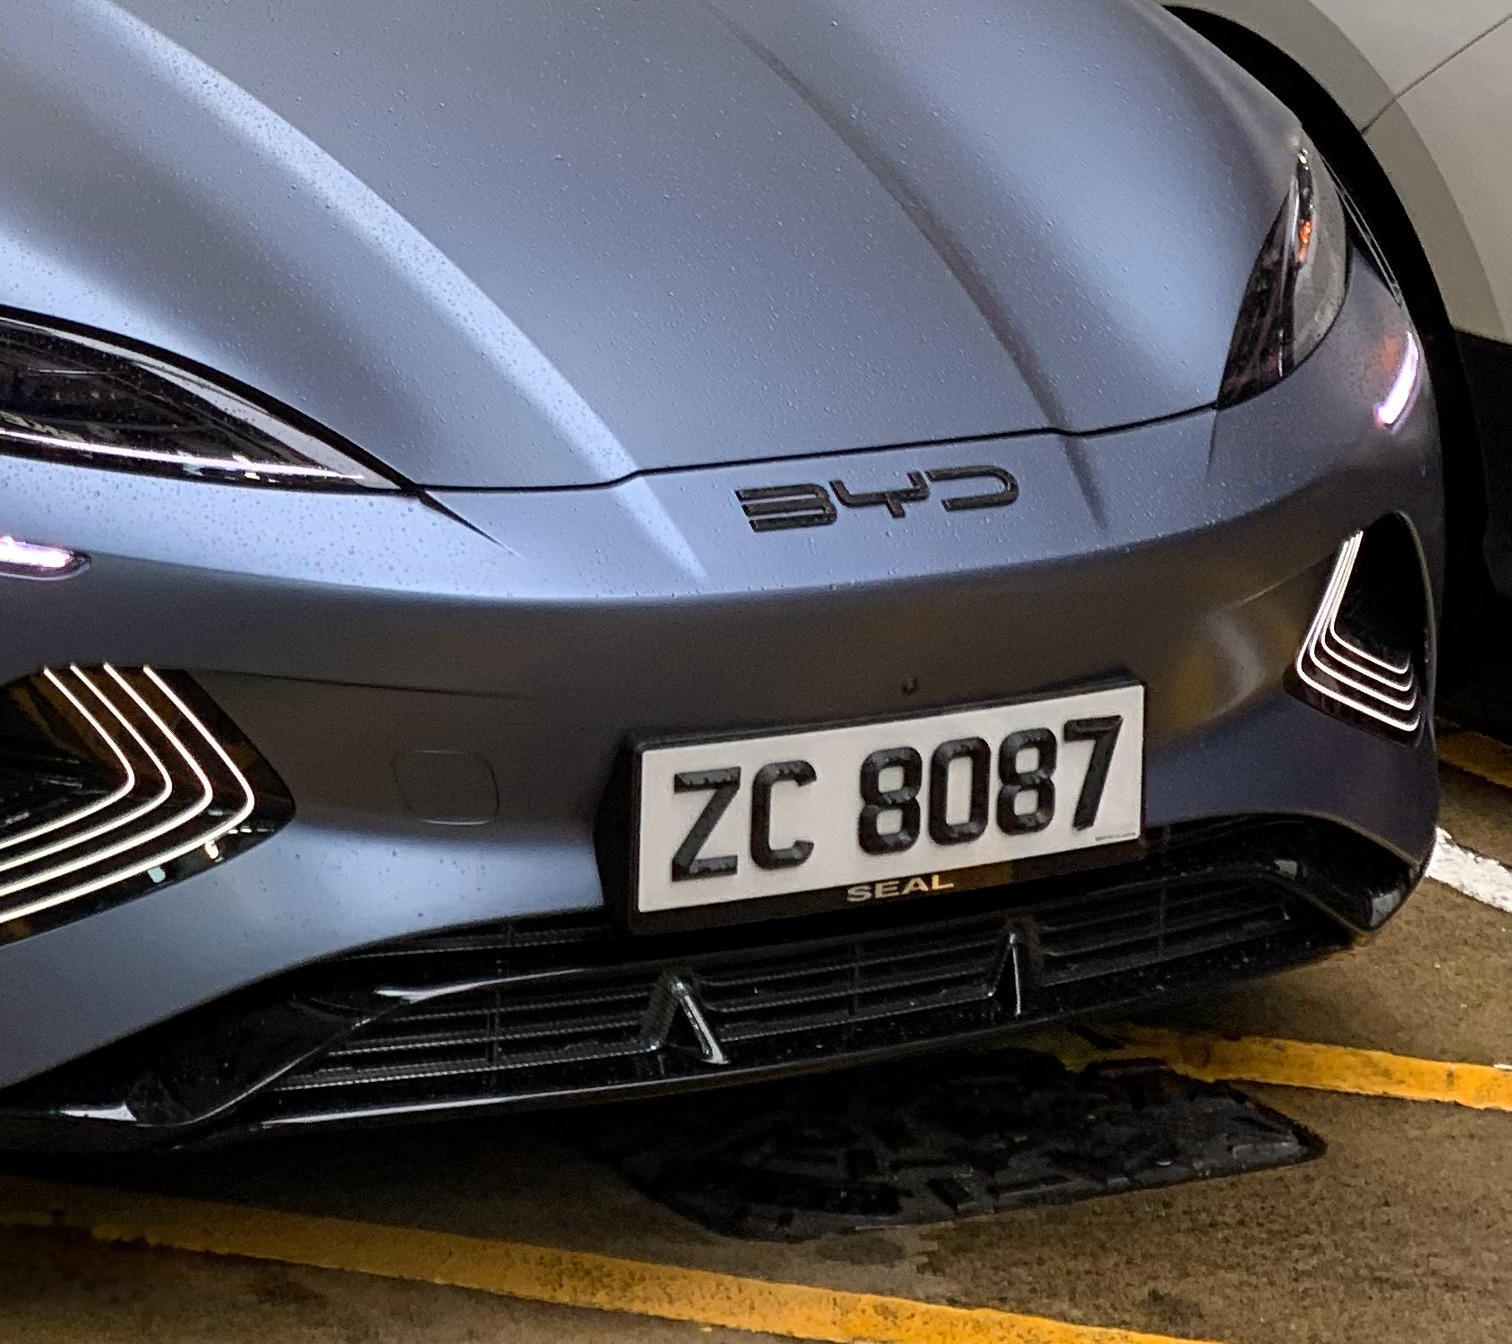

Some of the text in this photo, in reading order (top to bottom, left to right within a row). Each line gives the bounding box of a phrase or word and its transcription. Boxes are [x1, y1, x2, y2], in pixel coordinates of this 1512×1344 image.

[734, 463, 1021, 533] BYD
[670, 714, 1124, 883] ZC 8087
[845, 872, 954, 903] SEAL
